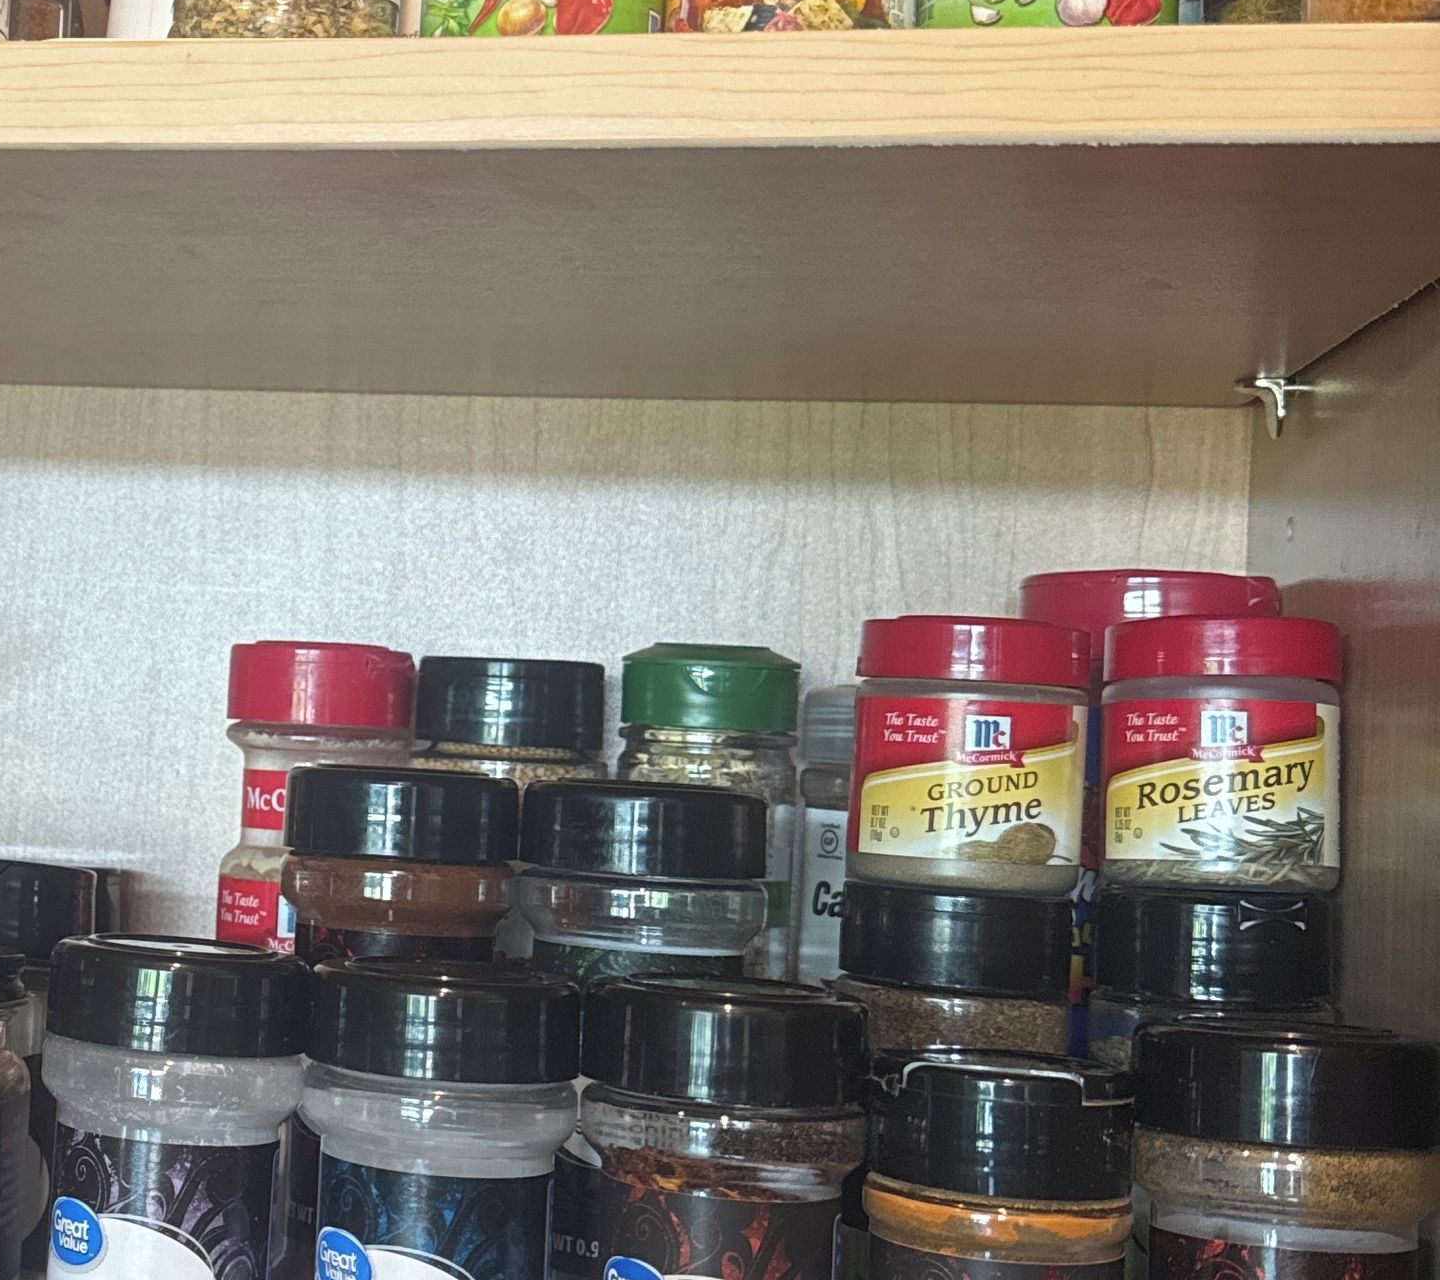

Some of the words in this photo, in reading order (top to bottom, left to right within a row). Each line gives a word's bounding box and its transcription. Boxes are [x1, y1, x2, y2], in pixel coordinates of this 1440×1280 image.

[926, 770, 1038, 800] GROUND
[1136, 759, 1315, 810] Rosemary
[920, 794, 1042, 837] Thyme
[1178, 792, 1276, 824] LEAVES
[53, 1208, 90, 1241] Great
[58, 1232, 88, 1255] Value
